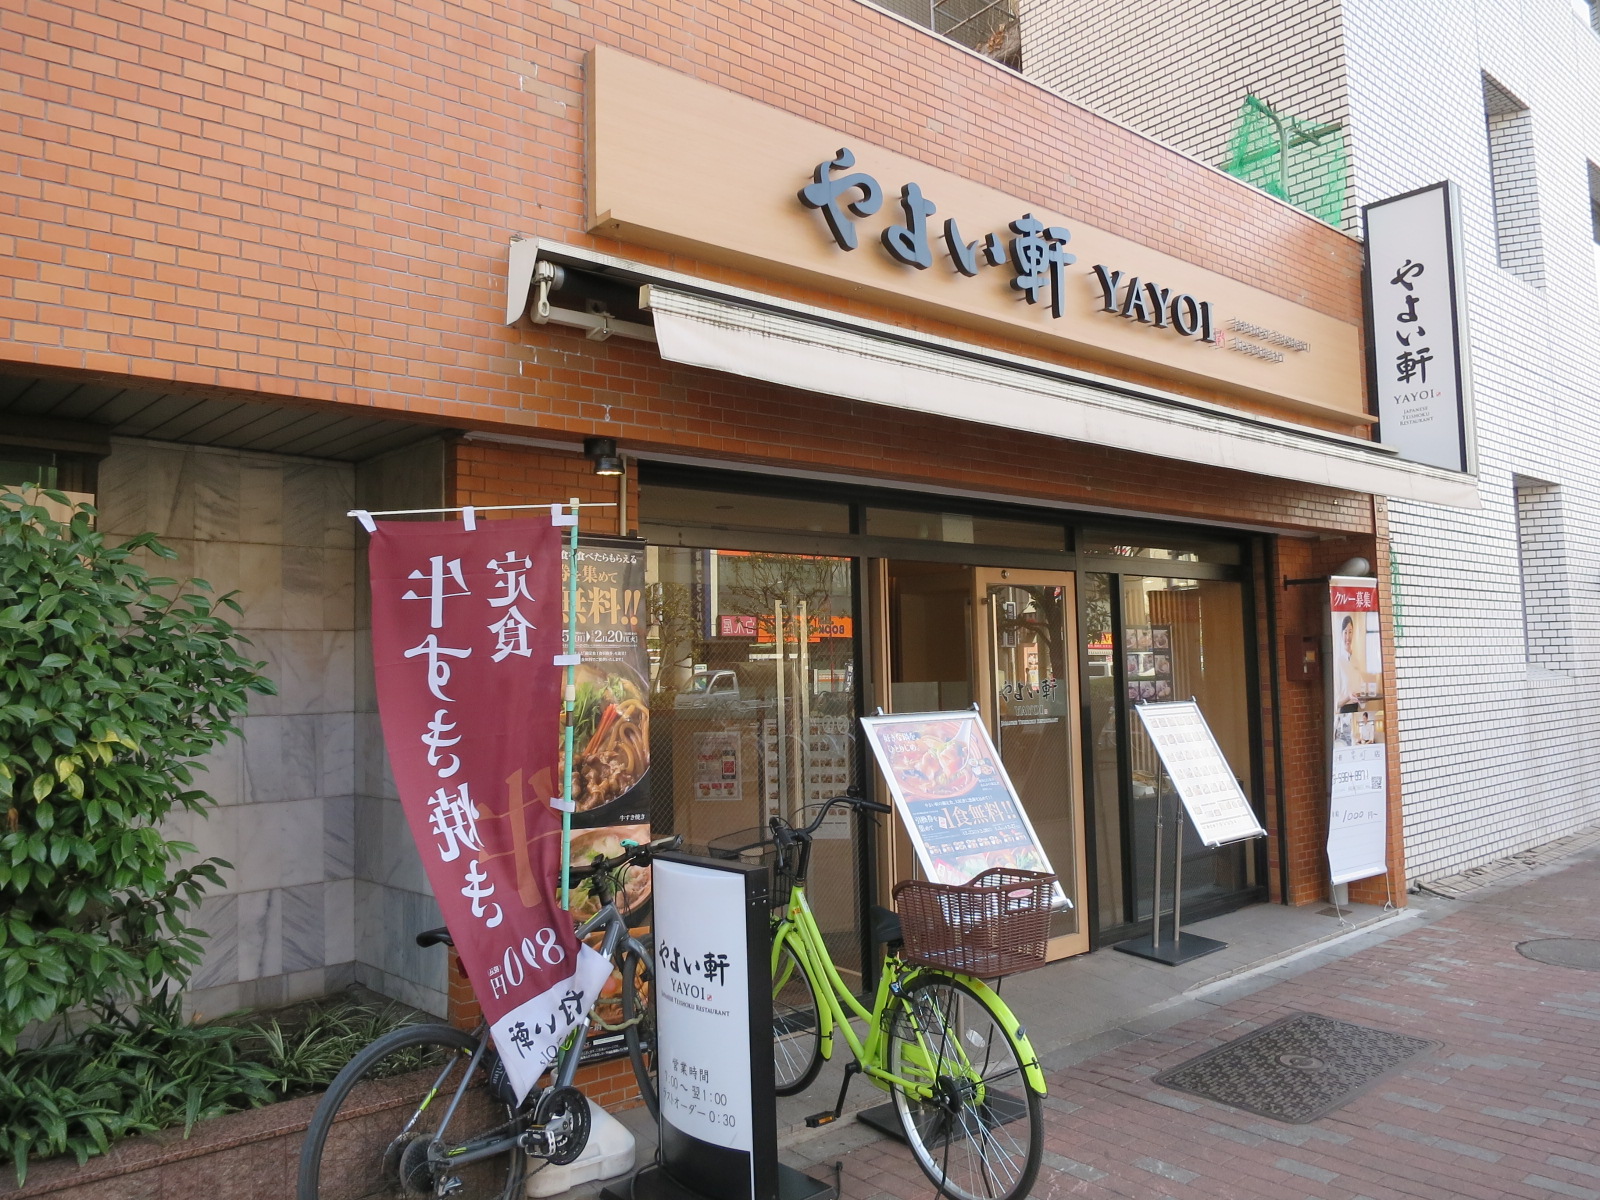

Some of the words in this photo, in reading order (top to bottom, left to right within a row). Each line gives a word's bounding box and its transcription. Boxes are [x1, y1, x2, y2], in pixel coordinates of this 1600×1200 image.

[799, 147, 1077, 319] やよい軒
[1092, 264, 1216, 343] YAYOI
[1390, 259, 1434, 384] やよい軒
[1394, 389, 1435, 405] YAYOI
[1334, 591, 1372, 609] クルー募集
[659, 939, 731, 987] やよい軒
[670, 978, 706, 1001] YAYOI
[672, 1058, 709, 1084] 営業時間
